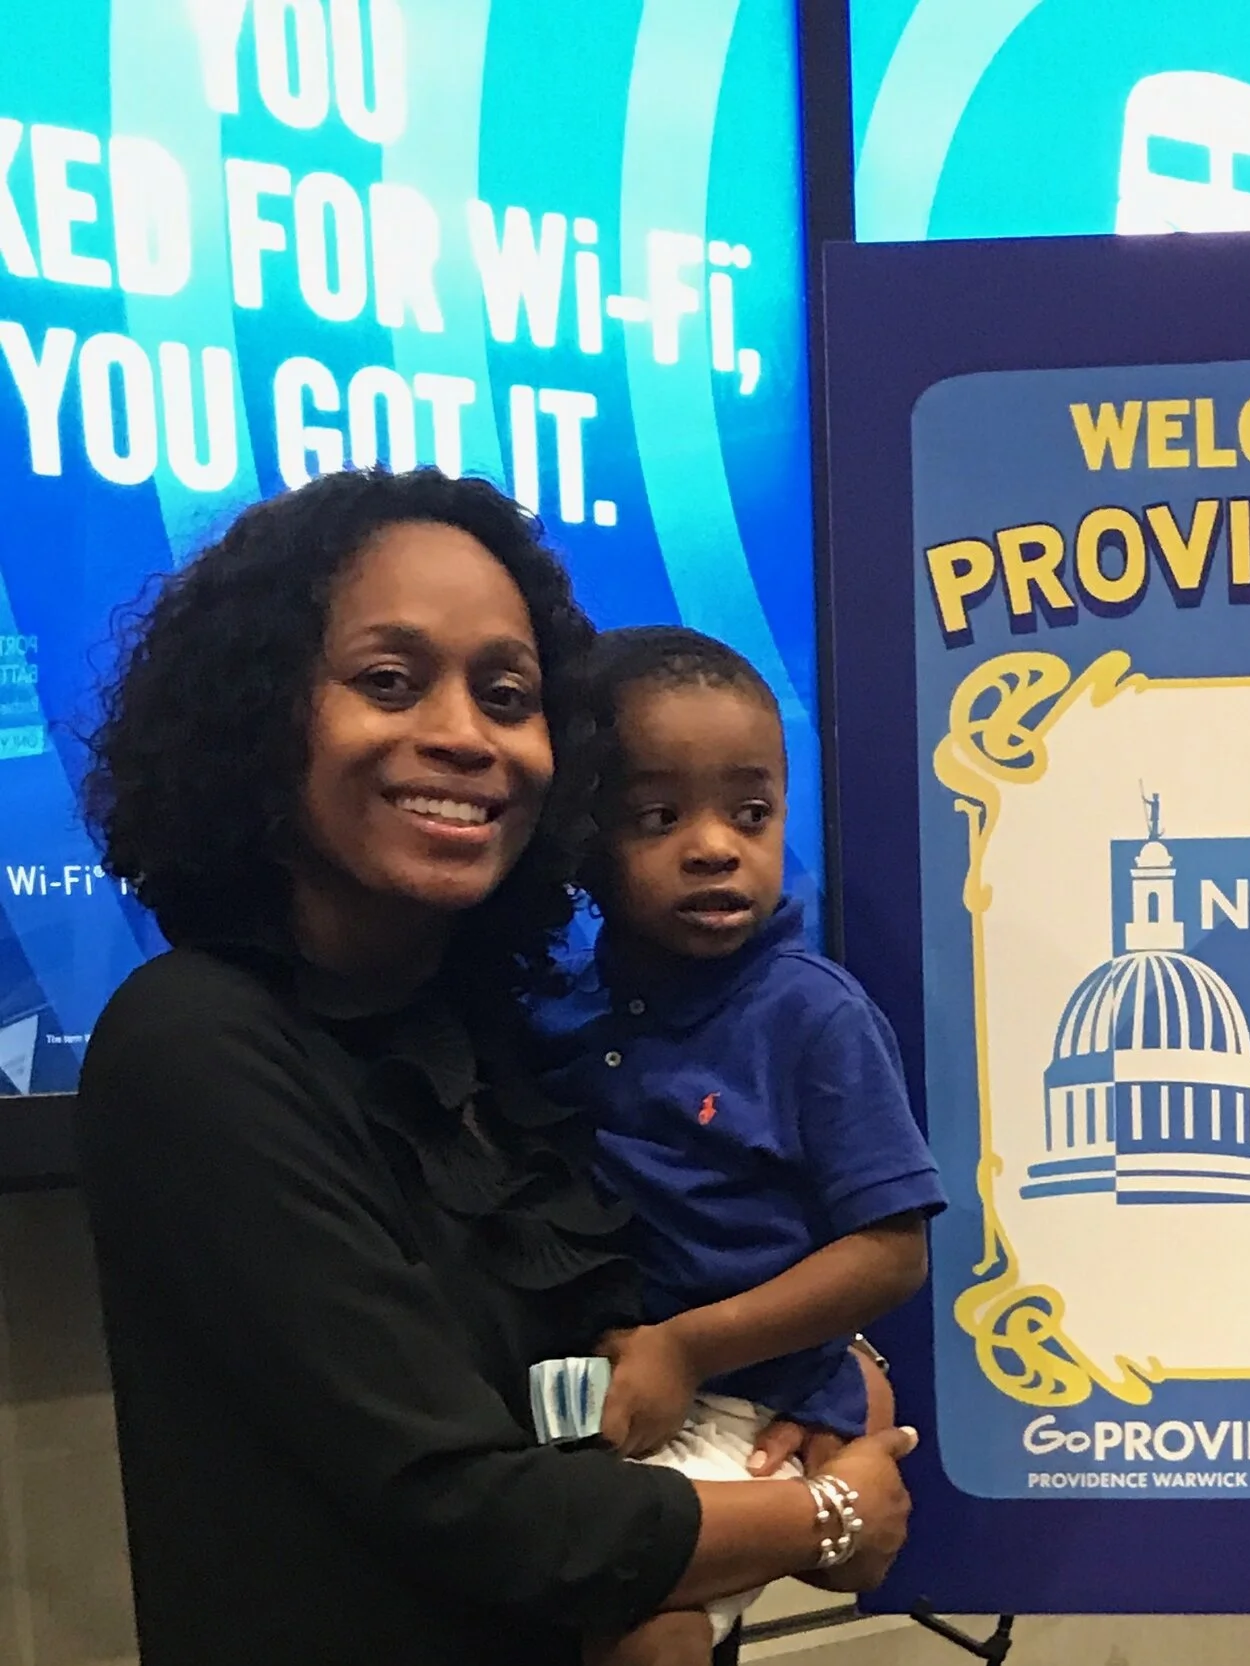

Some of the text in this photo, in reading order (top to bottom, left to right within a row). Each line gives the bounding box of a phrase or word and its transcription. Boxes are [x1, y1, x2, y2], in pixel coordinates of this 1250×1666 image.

[199, 0, 404, 143] YOU
[224, 159, 445, 333] FOR
[0, 321, 238, 493] YOU
[509, 384, 618, 528] IT.
[1028, 1472, 1148, 1489] PROVIDENCE
[1152, 1471, 1248, 1489] WARWICK
